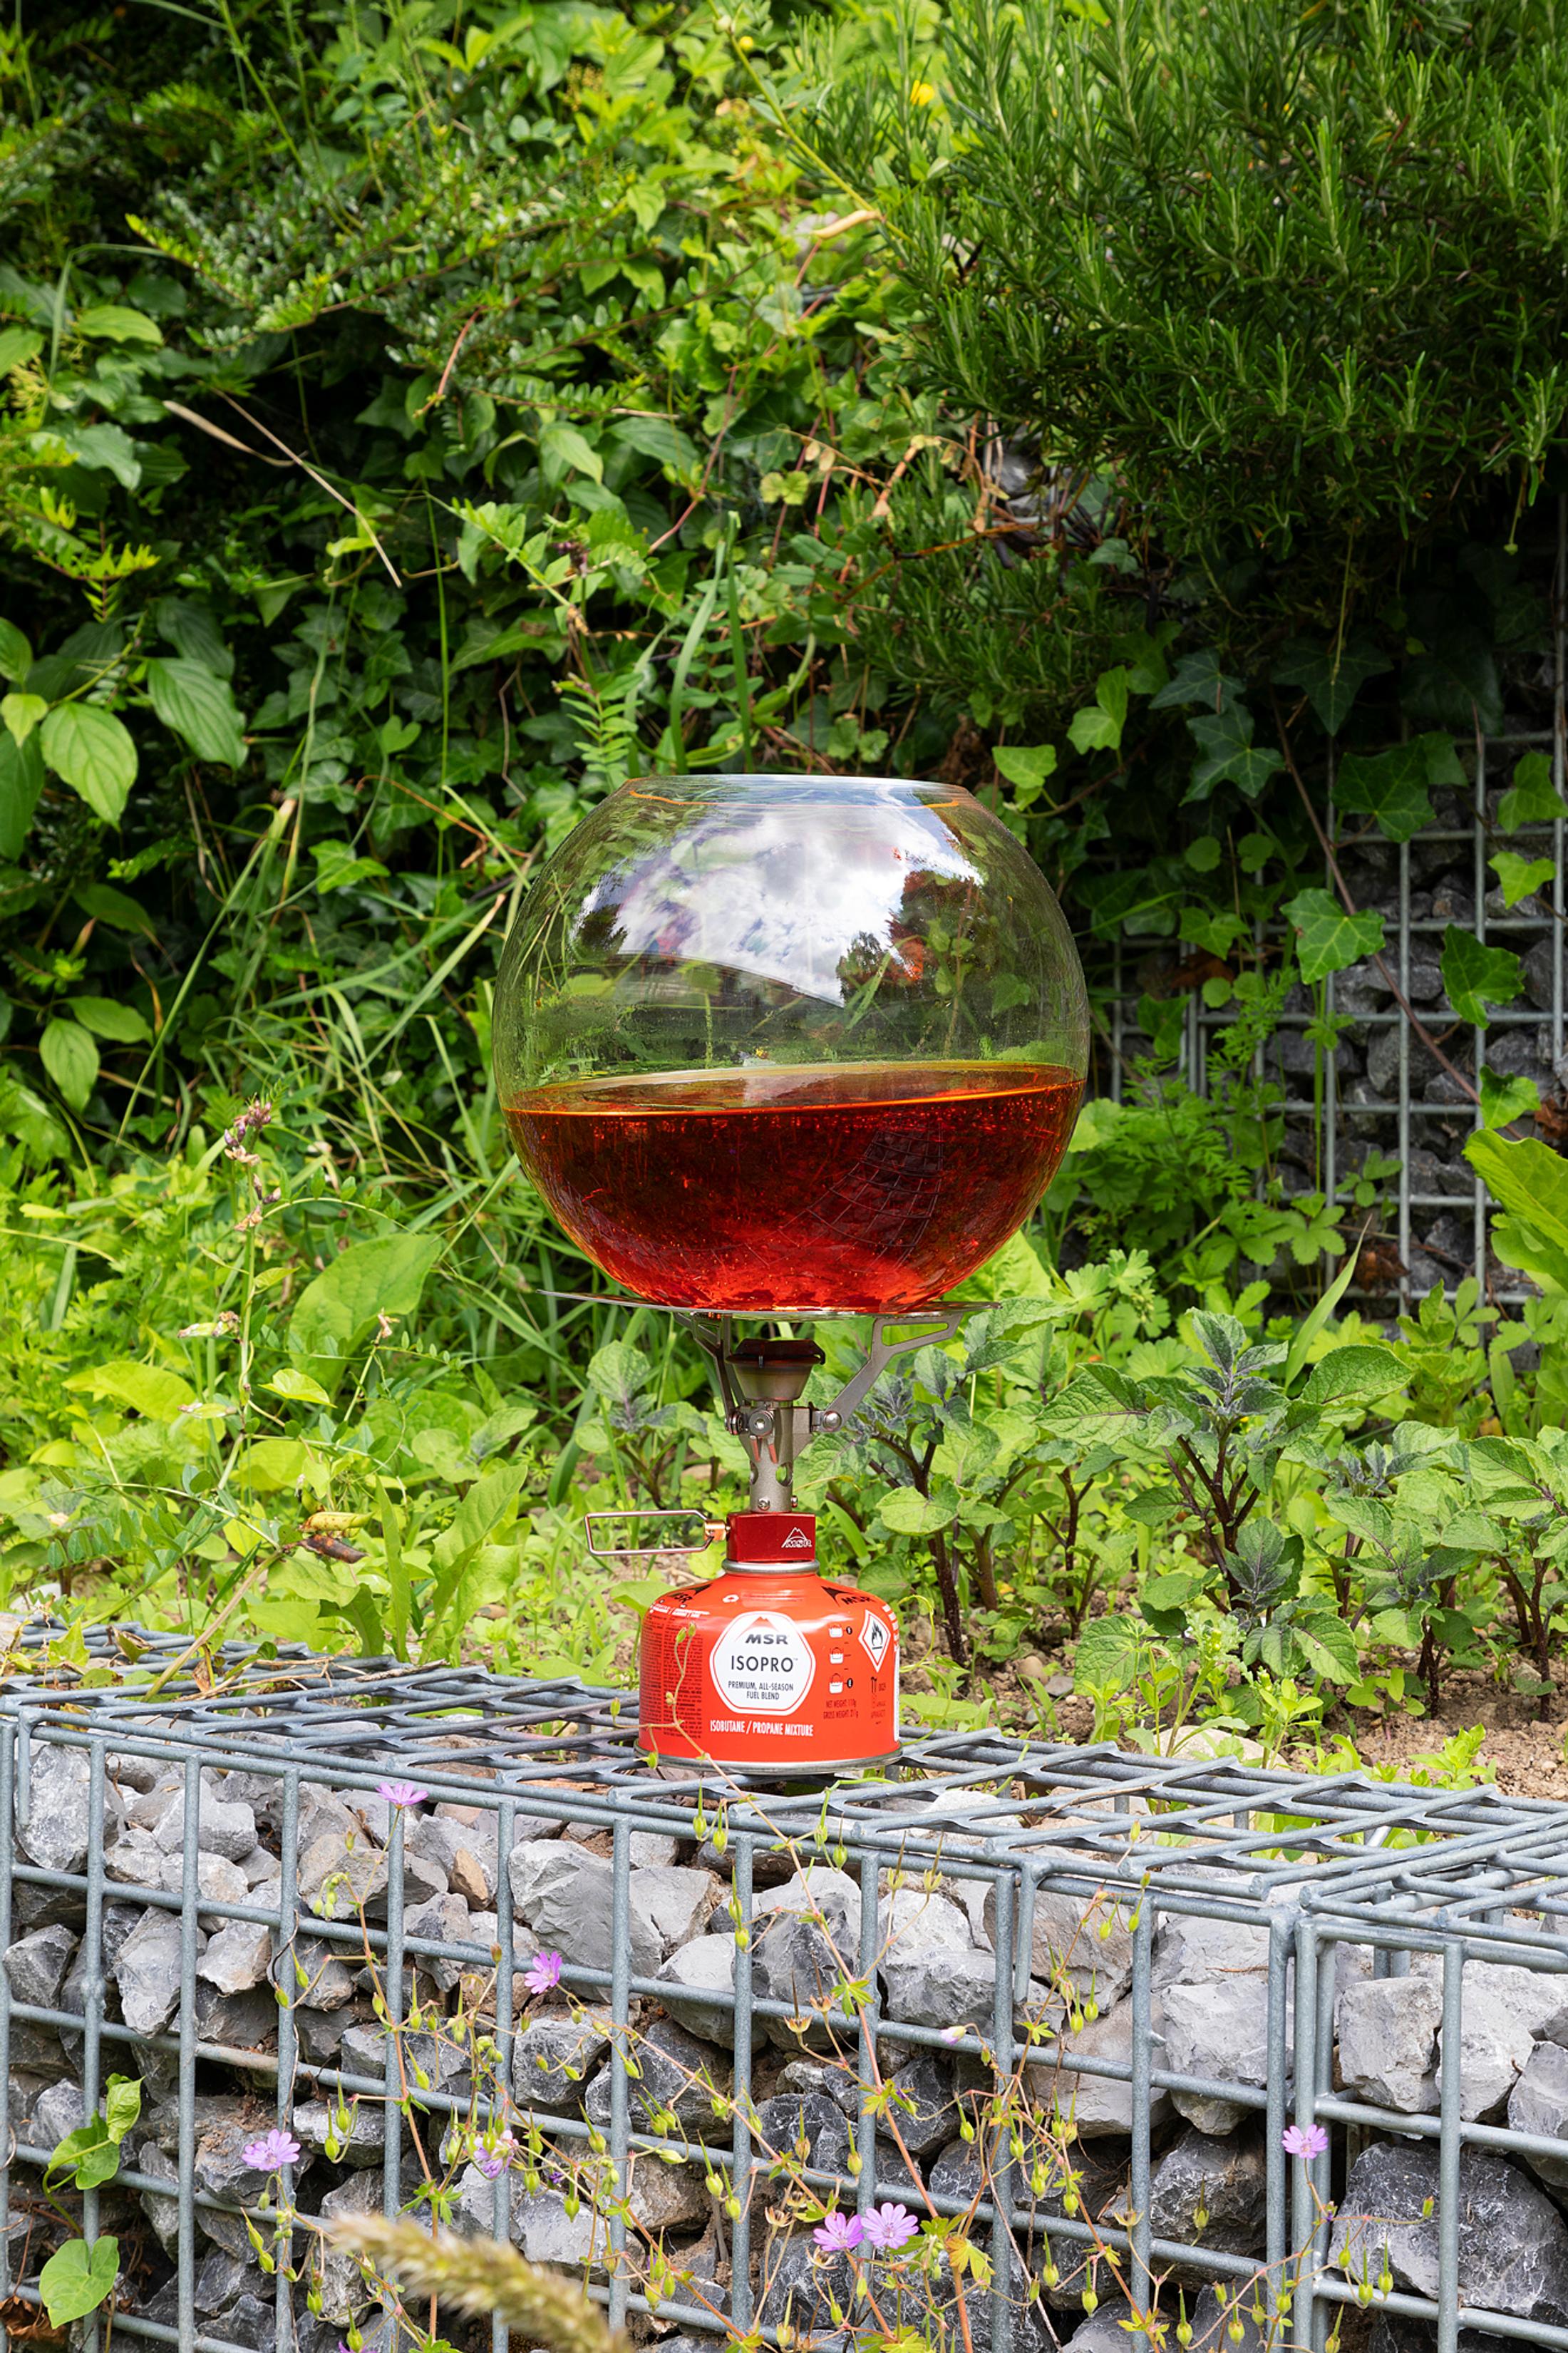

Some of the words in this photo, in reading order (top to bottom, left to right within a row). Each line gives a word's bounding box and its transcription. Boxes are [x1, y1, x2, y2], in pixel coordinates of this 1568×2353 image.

[841, 1596, 875, 1605] MSR
[745, 1634, 788, 1645] MSR
[728, 1680, 757, 1691] PREMIUM,
[758, 1682, 794, 1692] ALL-SEASON
[746, 1691, 760, 1700] FUEL
[761, 1692, 780, 1700] BLEND
[710, 1719, 746, 1733] ISOBUTANE
[746, 1720, 753, 1734] /
[753, 1721, 783, 1735] PROPANE
[785, 1724, 814, 1737] MIXTURE
